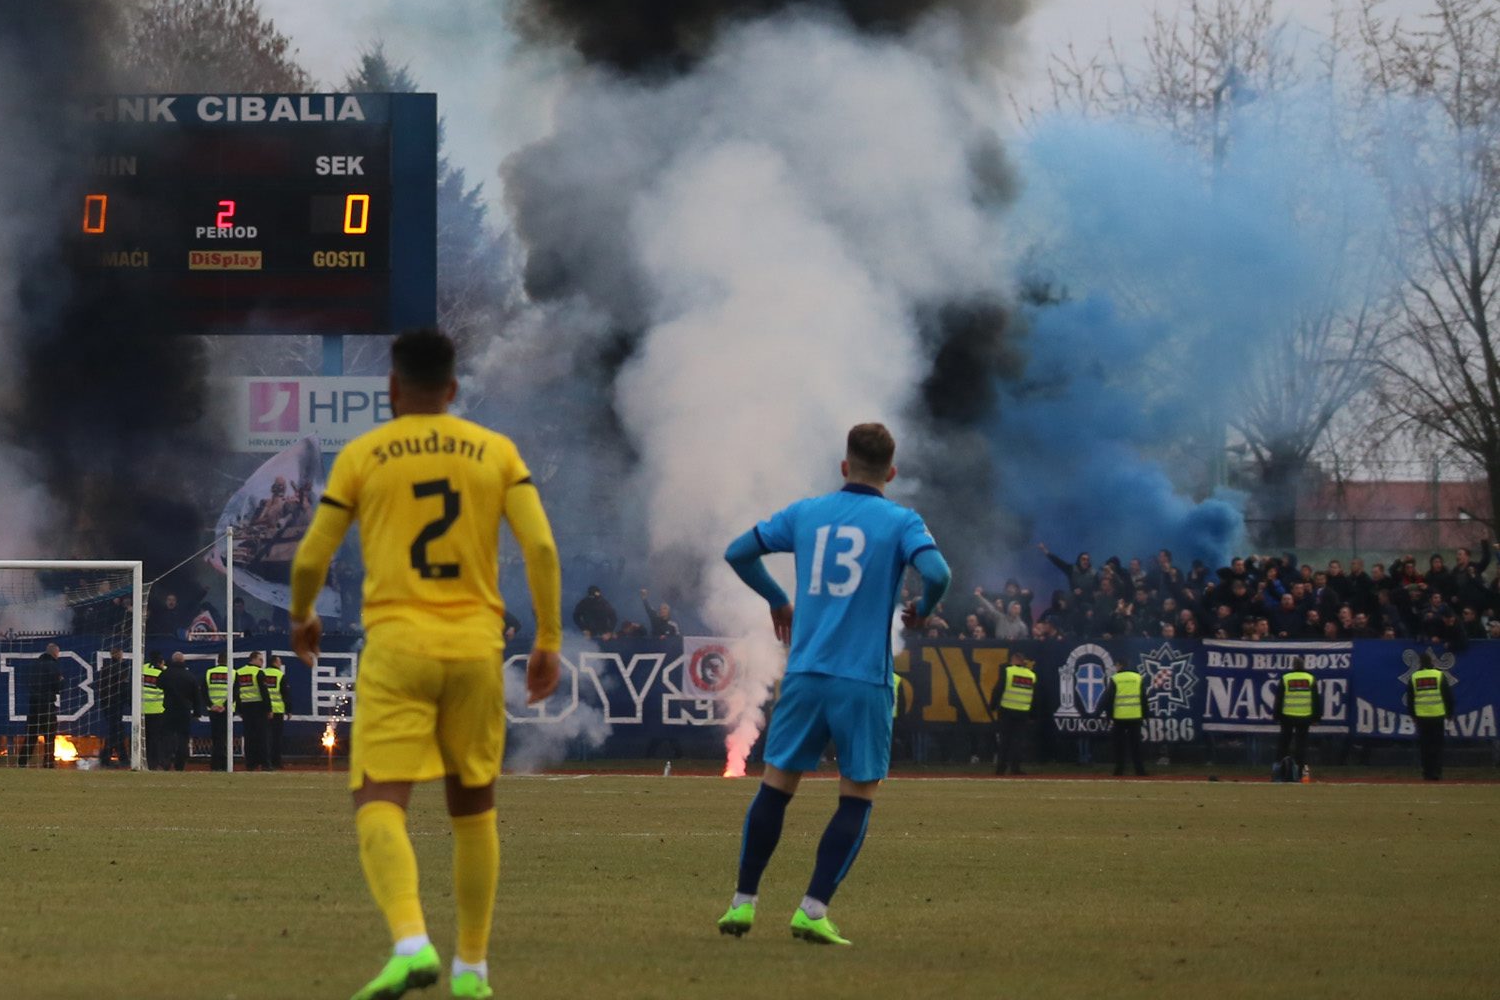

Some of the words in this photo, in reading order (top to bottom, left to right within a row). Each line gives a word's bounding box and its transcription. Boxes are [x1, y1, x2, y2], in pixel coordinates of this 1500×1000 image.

[197, 96, 366, 122] CIBALIA
[315, 156, 365, 175] SEK
[83, 194, 108, 234] 0
[216, 200, 235, 228] 2
[343, 194, 370, 234] 0
[196, 226, 258, 239] PERIOD
[313, 251, 366, 268] GOSTI
[372, 430, 487, 465] soudani
[410, 479, 460, 580] 2
[808, 524, 866, 598] 13
[1207, 652, 1249, 668] BAD
[1304, 653, 1352, 669] BOYS
[1356, 696, 1498, 738] DUBAVA
